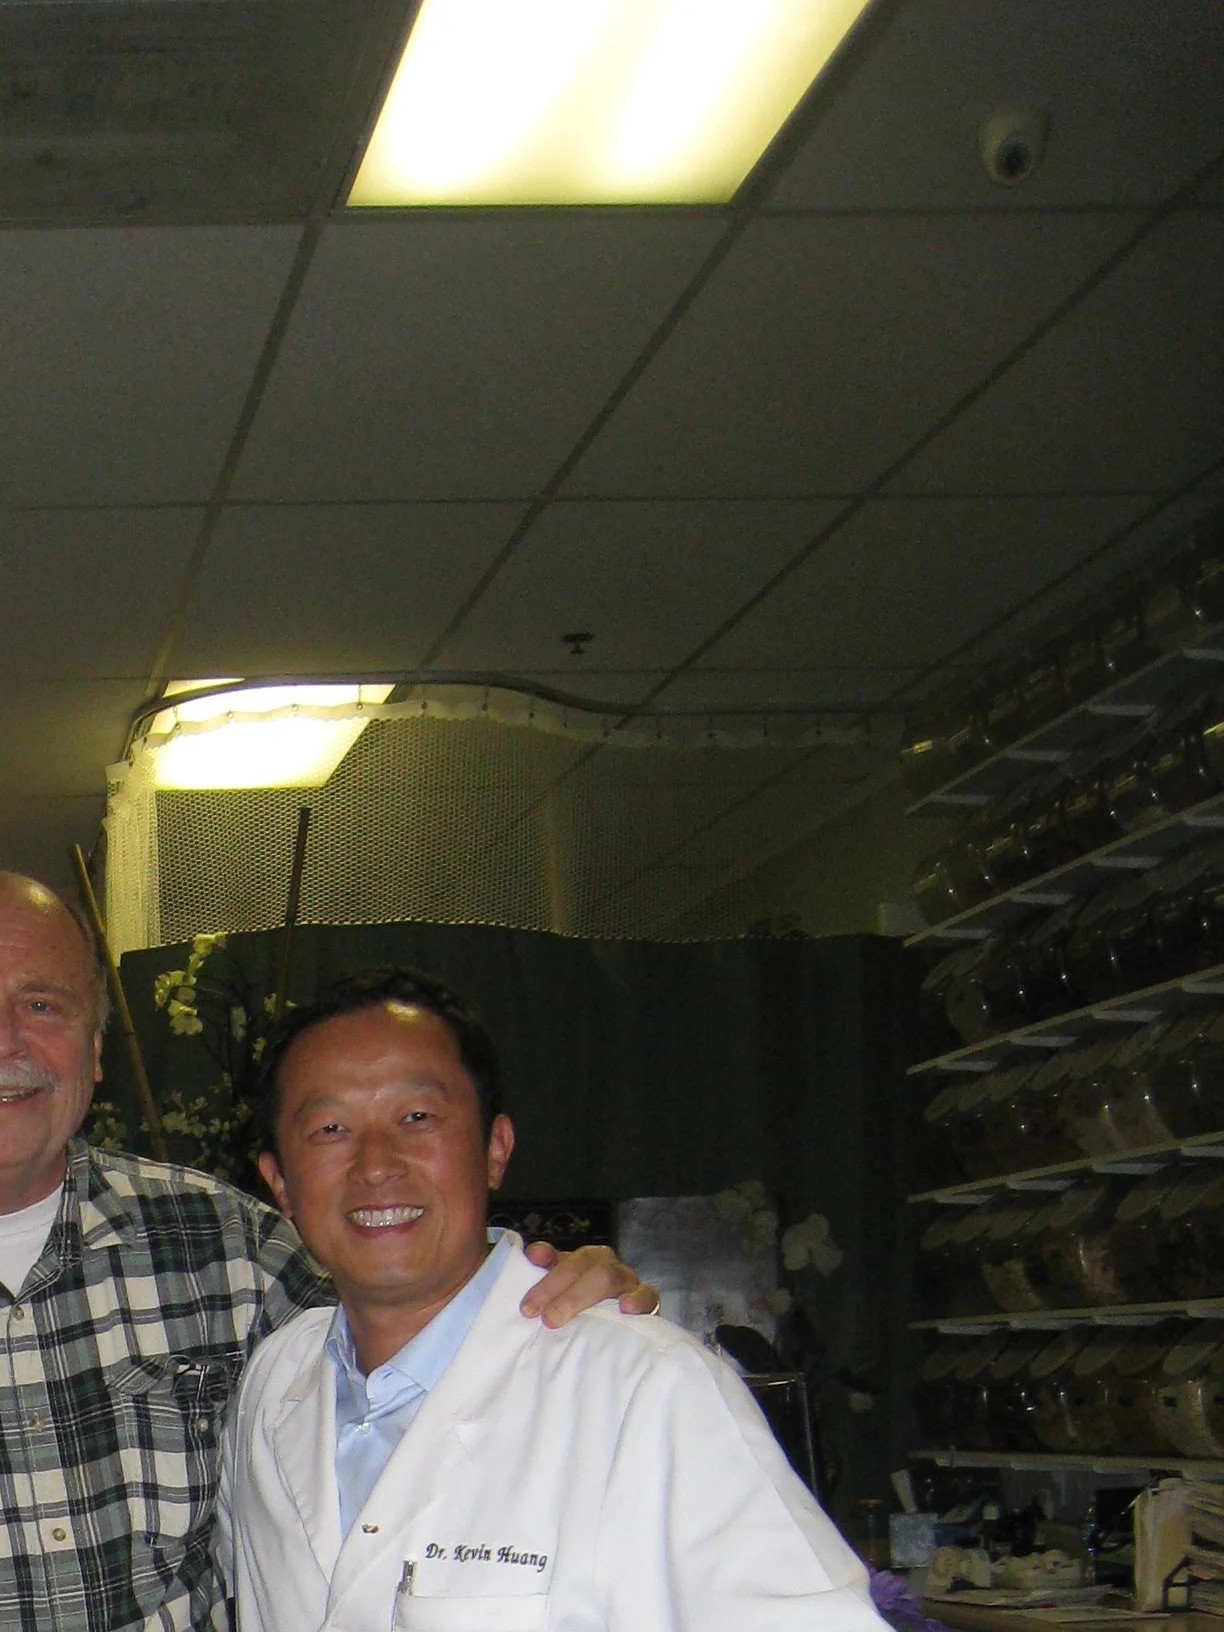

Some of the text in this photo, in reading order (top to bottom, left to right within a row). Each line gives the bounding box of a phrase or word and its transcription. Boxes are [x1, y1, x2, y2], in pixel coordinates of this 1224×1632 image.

[425, 1542, 548, 1572] Dr. Kevin Huang
